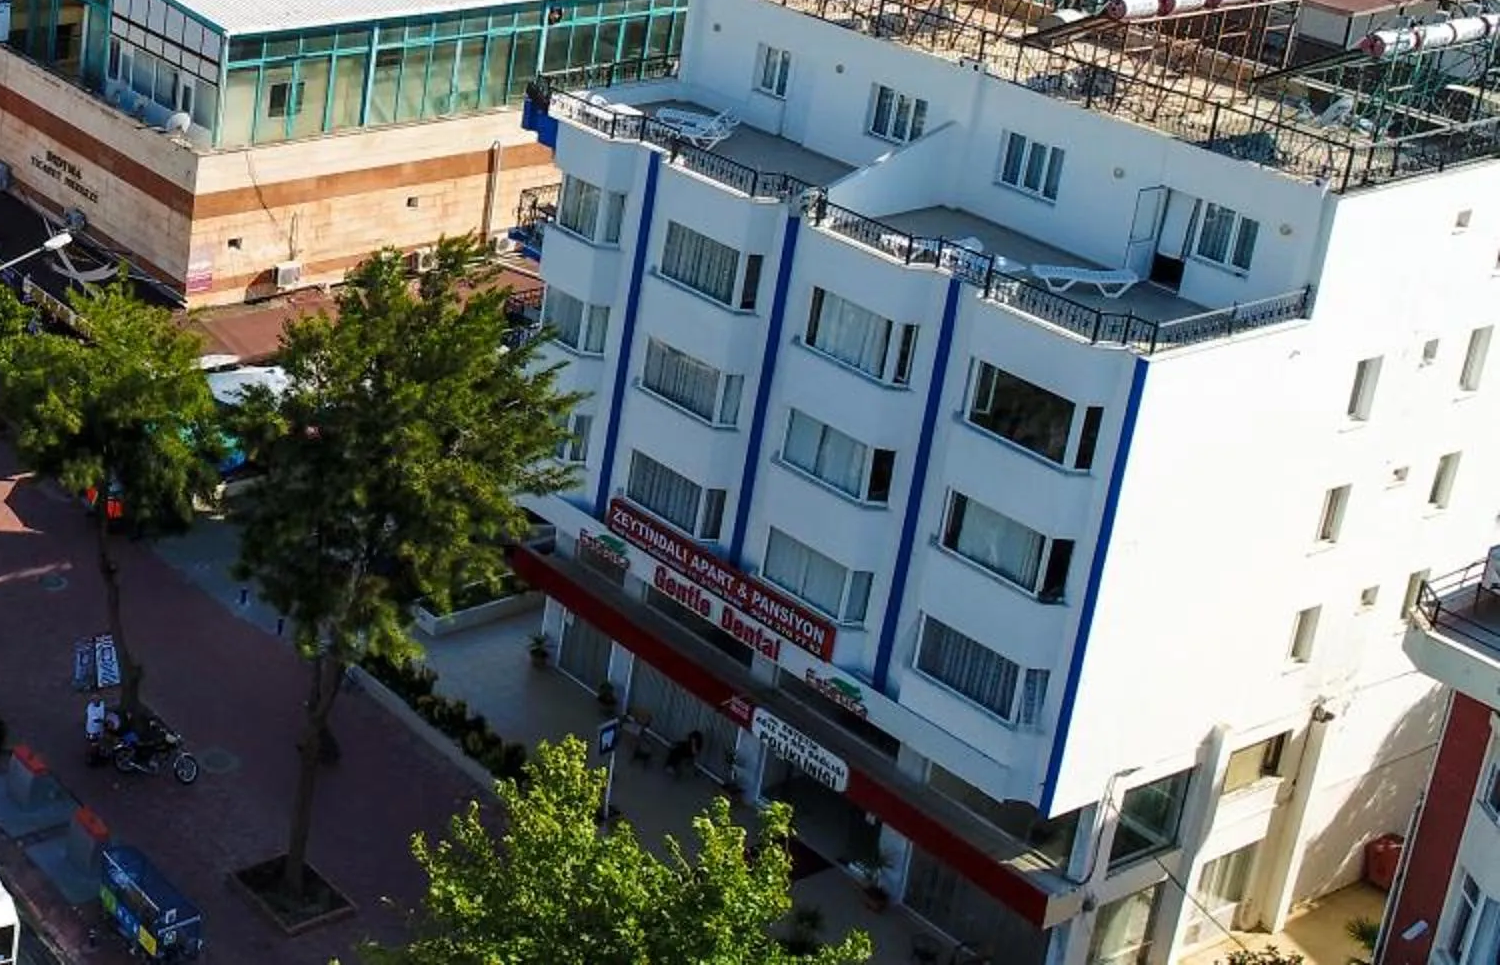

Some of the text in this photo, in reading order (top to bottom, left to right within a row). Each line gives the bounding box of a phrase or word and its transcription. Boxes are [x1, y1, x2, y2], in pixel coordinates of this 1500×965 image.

[654, 565, 781, 662] Gentle Dental
[690, 554, 735, 591] APART
[751, 590, 826, 645] PANSİYON
